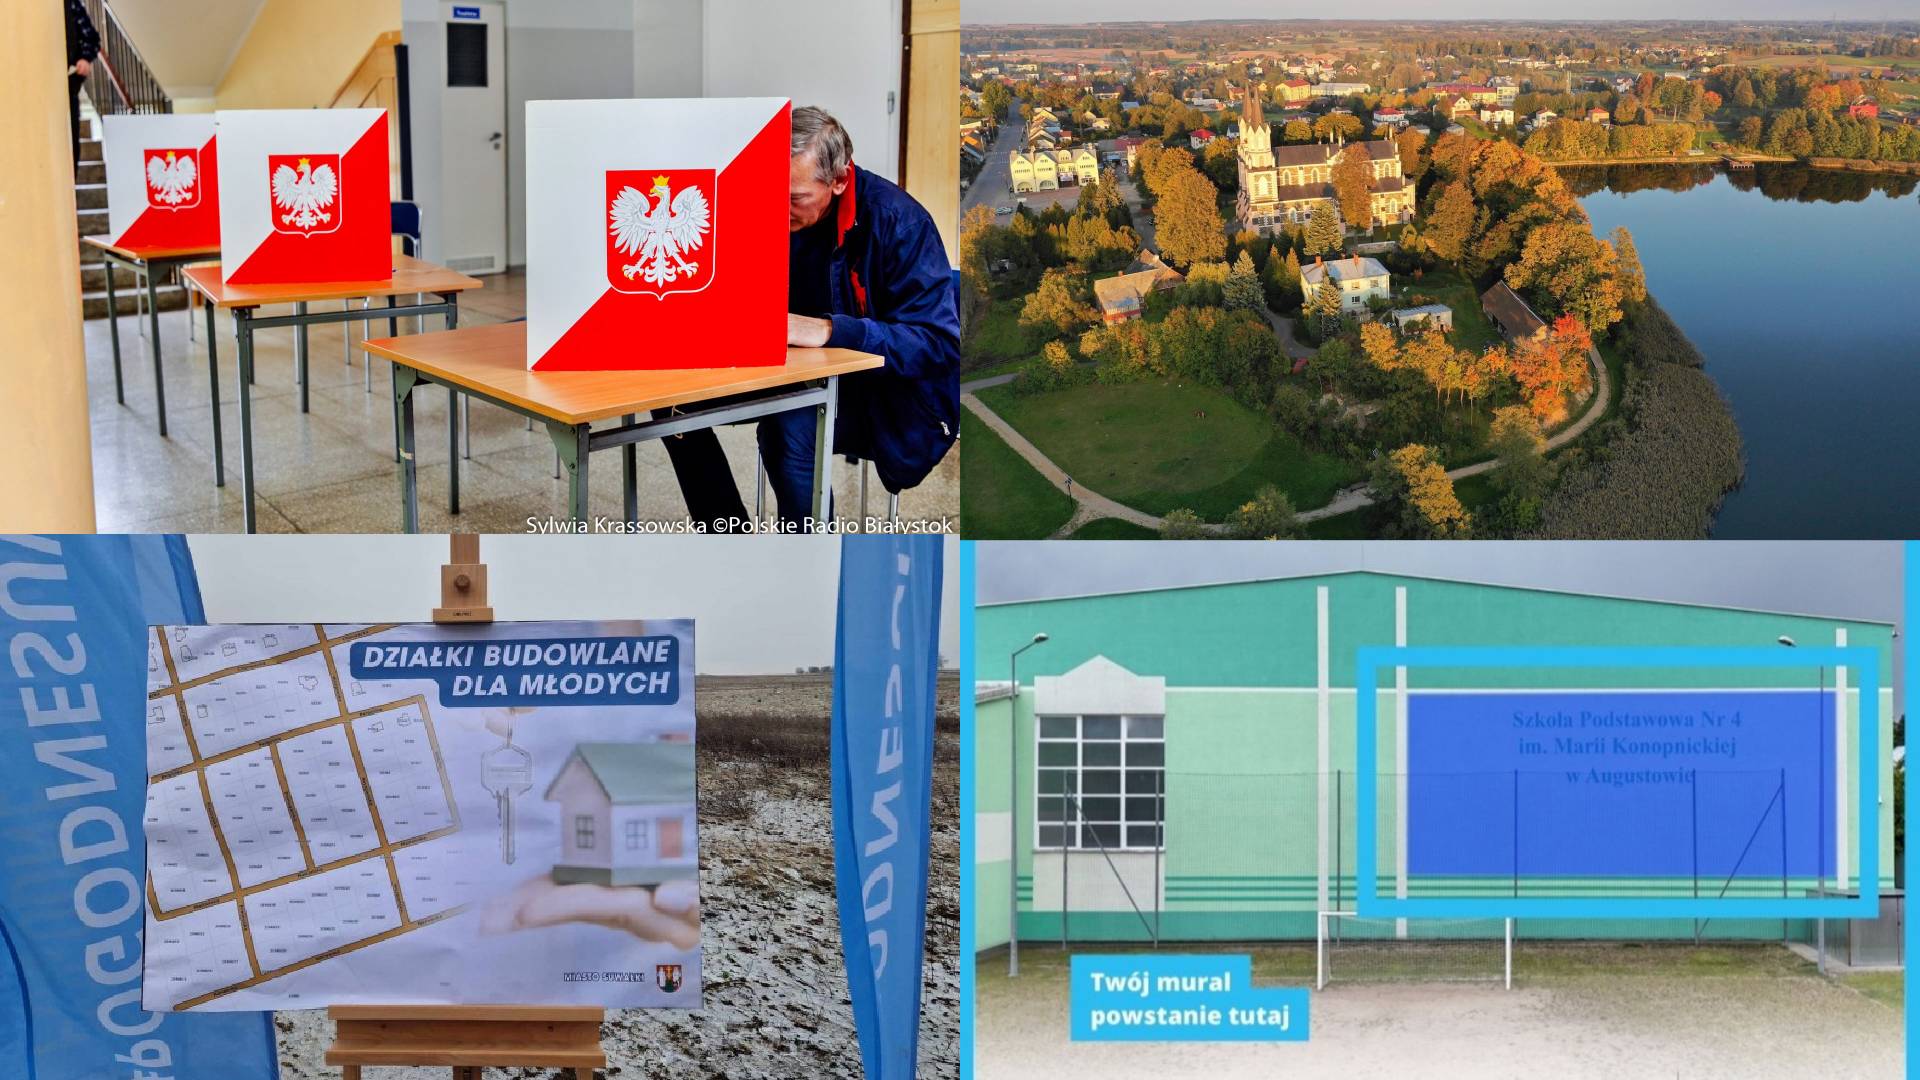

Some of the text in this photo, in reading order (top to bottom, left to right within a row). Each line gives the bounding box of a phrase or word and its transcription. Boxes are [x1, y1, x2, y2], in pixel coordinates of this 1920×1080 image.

[363, 639, 671, 667] DZIAŁKI BUDOWLANE
[452, 671, 670, 696] DLA MŁODYCH
[1512, 711, 1742, 729] Szkoła Podstawowa Nr 4
[1519, 737, 1737, 759] im. Marii Konopnickiej
[1565, 767, 1694, 787] w Augustowie
[563, 972, 600, 982] MIASTO
